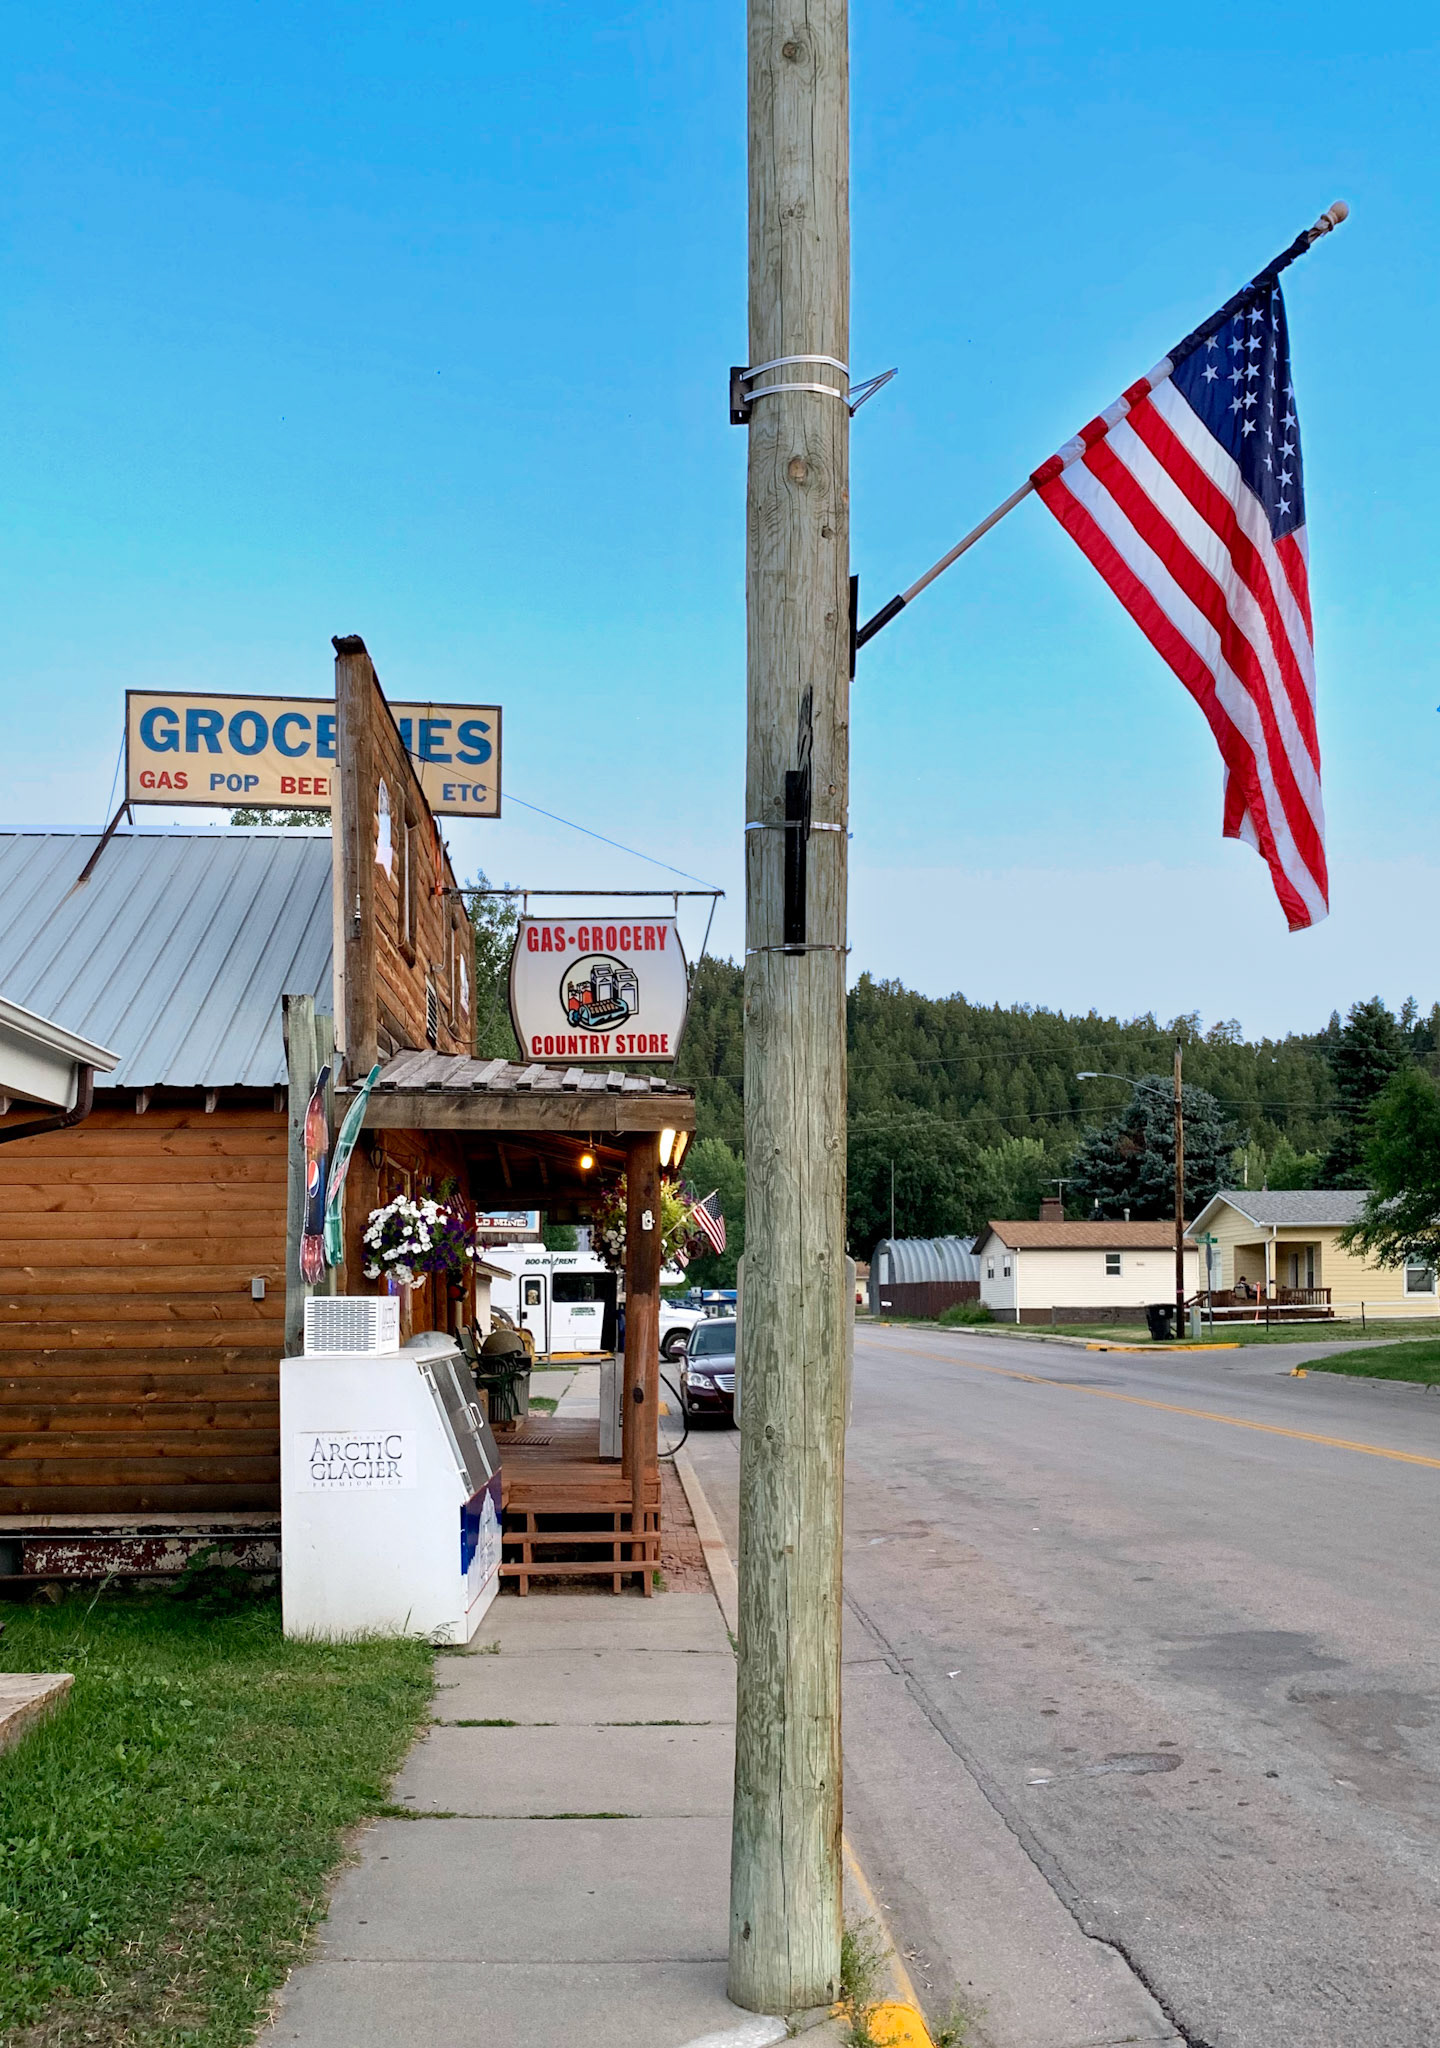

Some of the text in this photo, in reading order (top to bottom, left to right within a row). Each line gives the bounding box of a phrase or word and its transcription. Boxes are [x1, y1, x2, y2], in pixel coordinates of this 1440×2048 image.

[139, 706, 492, 765] GROCEIES
[139, 770, 488, 802] GAS POP BEE ETC
[531, 1034, 669, 1055] COUNTRY STORE
[475, 1218, 491, 1227] LD
[309, 1435, 403, 1461] ARCTIC
[311, 1461, 403, 1480] GLACIER
